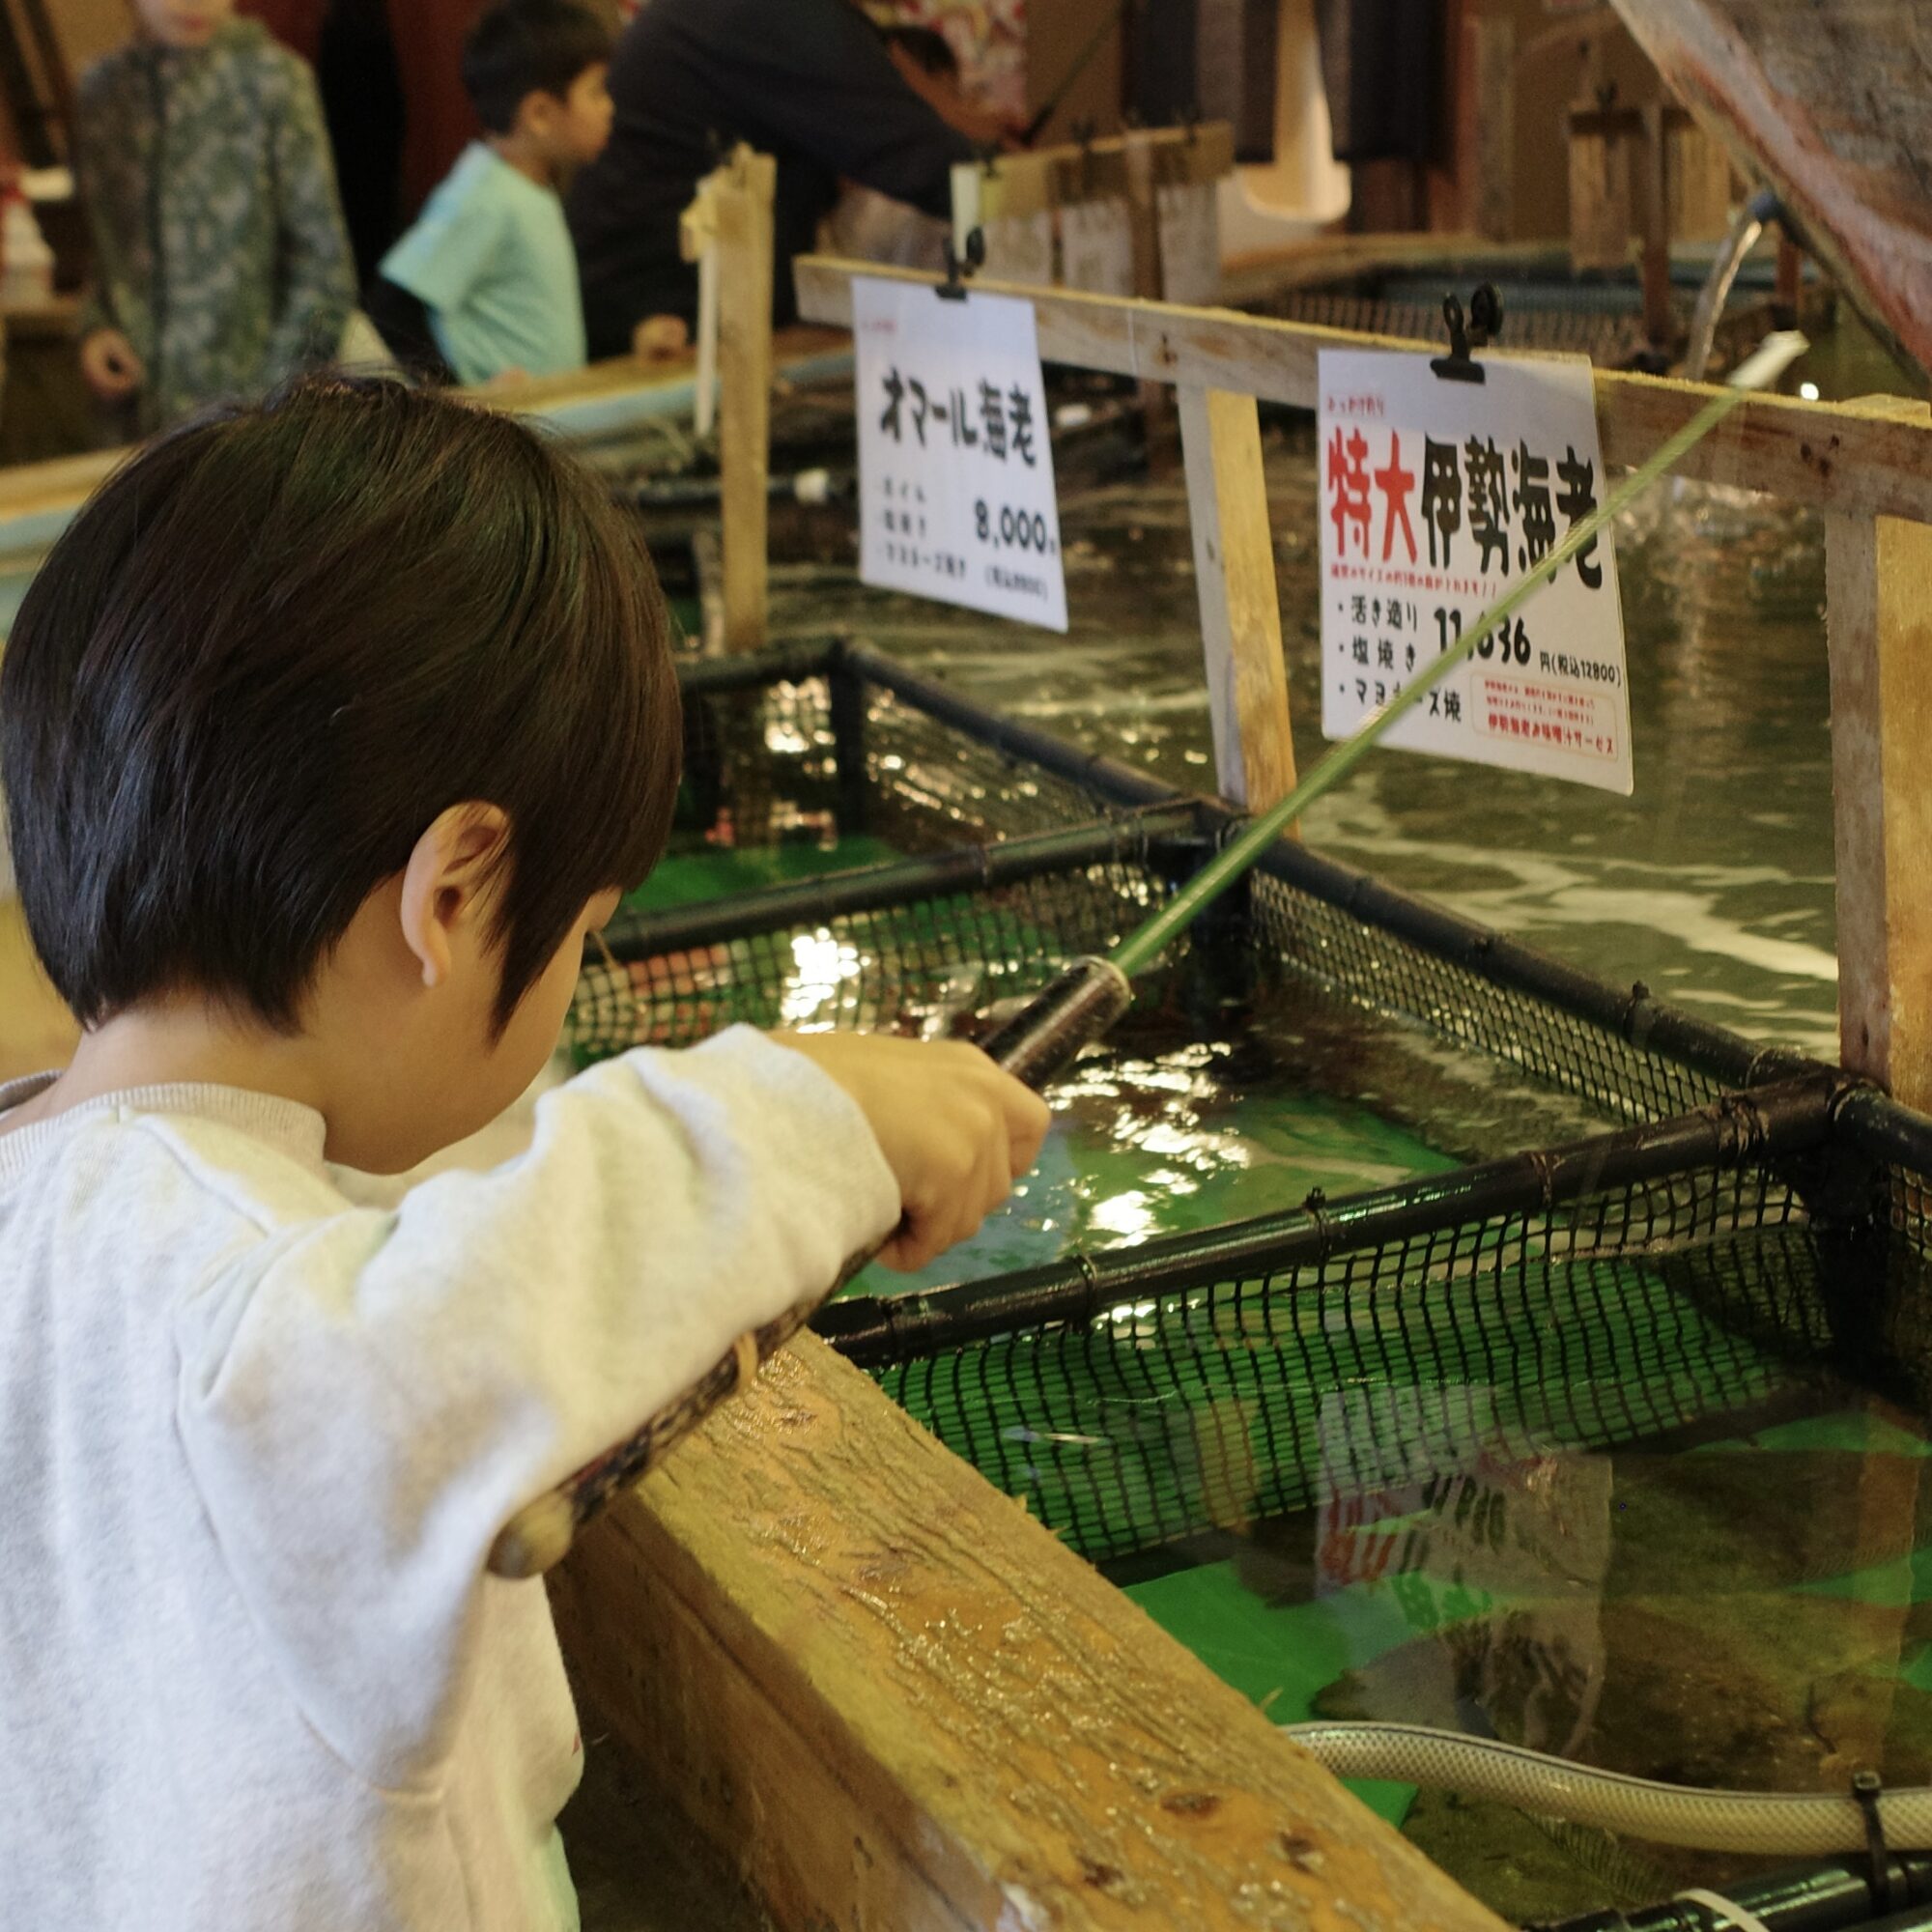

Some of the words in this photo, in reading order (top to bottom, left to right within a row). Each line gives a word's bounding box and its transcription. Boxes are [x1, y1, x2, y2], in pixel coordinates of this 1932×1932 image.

[880, 364, 1036, 468] オマール海老
[975, 498, 1047, 554] 8,000
[1328, 424, 1603, 589] 特大伊勢海老
[1351, 595, 1418, 634] 活き造り
[1352, 635, 1416, 673] 塩焼き
